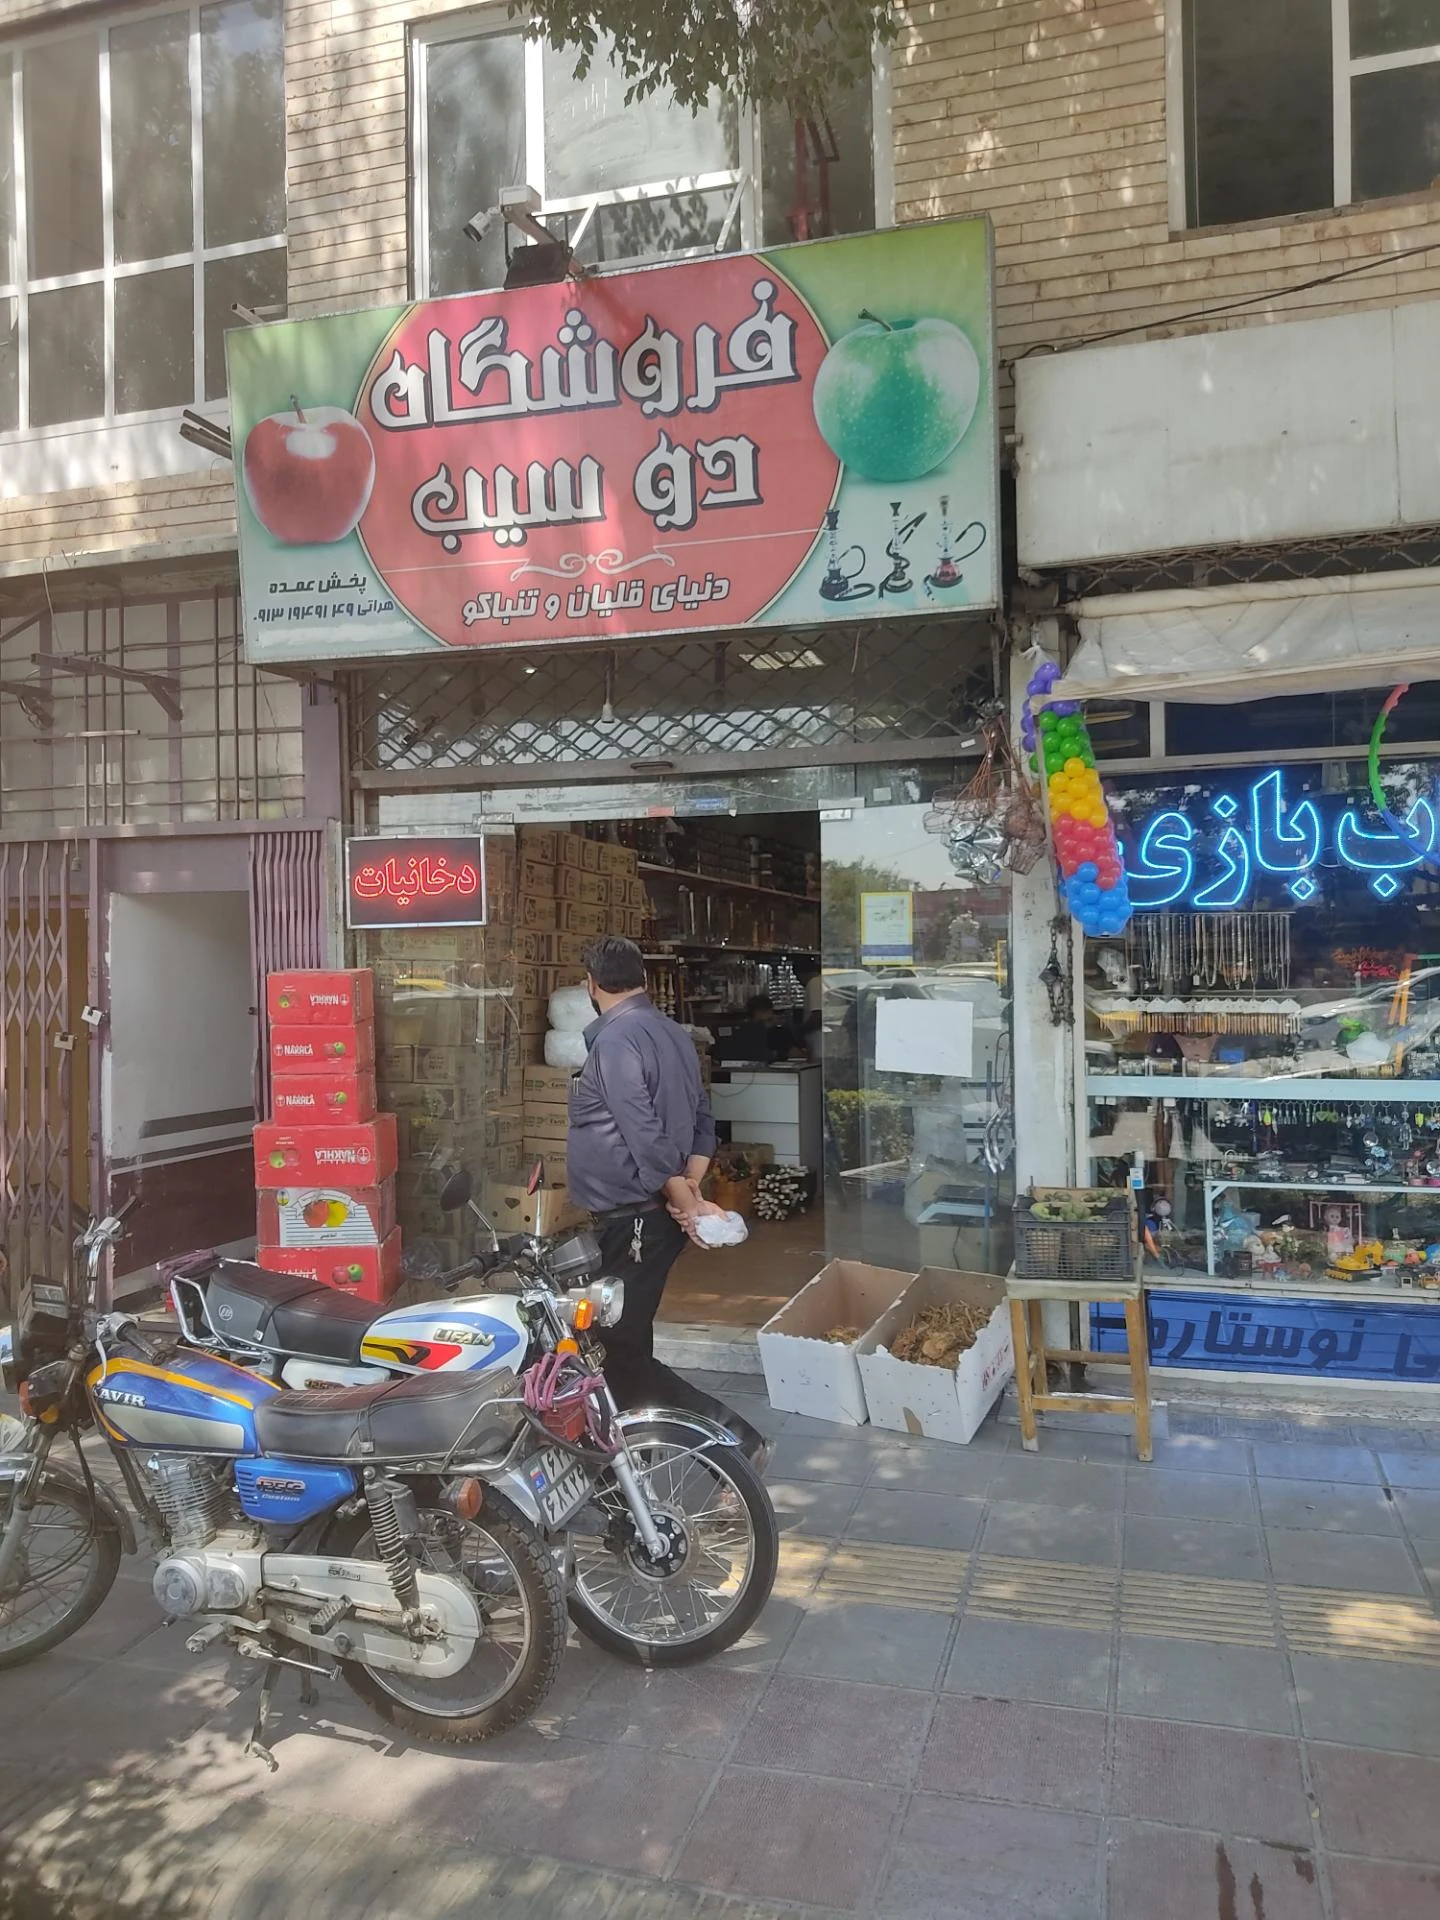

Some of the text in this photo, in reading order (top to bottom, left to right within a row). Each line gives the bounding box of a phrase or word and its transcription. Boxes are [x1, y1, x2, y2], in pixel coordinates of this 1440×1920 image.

[370, 280, 800, 431] فروشگاه
[411, 431, 762, 553] دو سیب
[269, 571, 367, 595] پخش عمده
[356, 599, 393, 616] هراتی
[462, 572, 730, 626] دنیای قلیان و تنباکو
[1118, 769, 1320, 906] بازی
[354, 857, 477, 905] دخانیات
[433, 1328, 496, 1346] LIFAN
